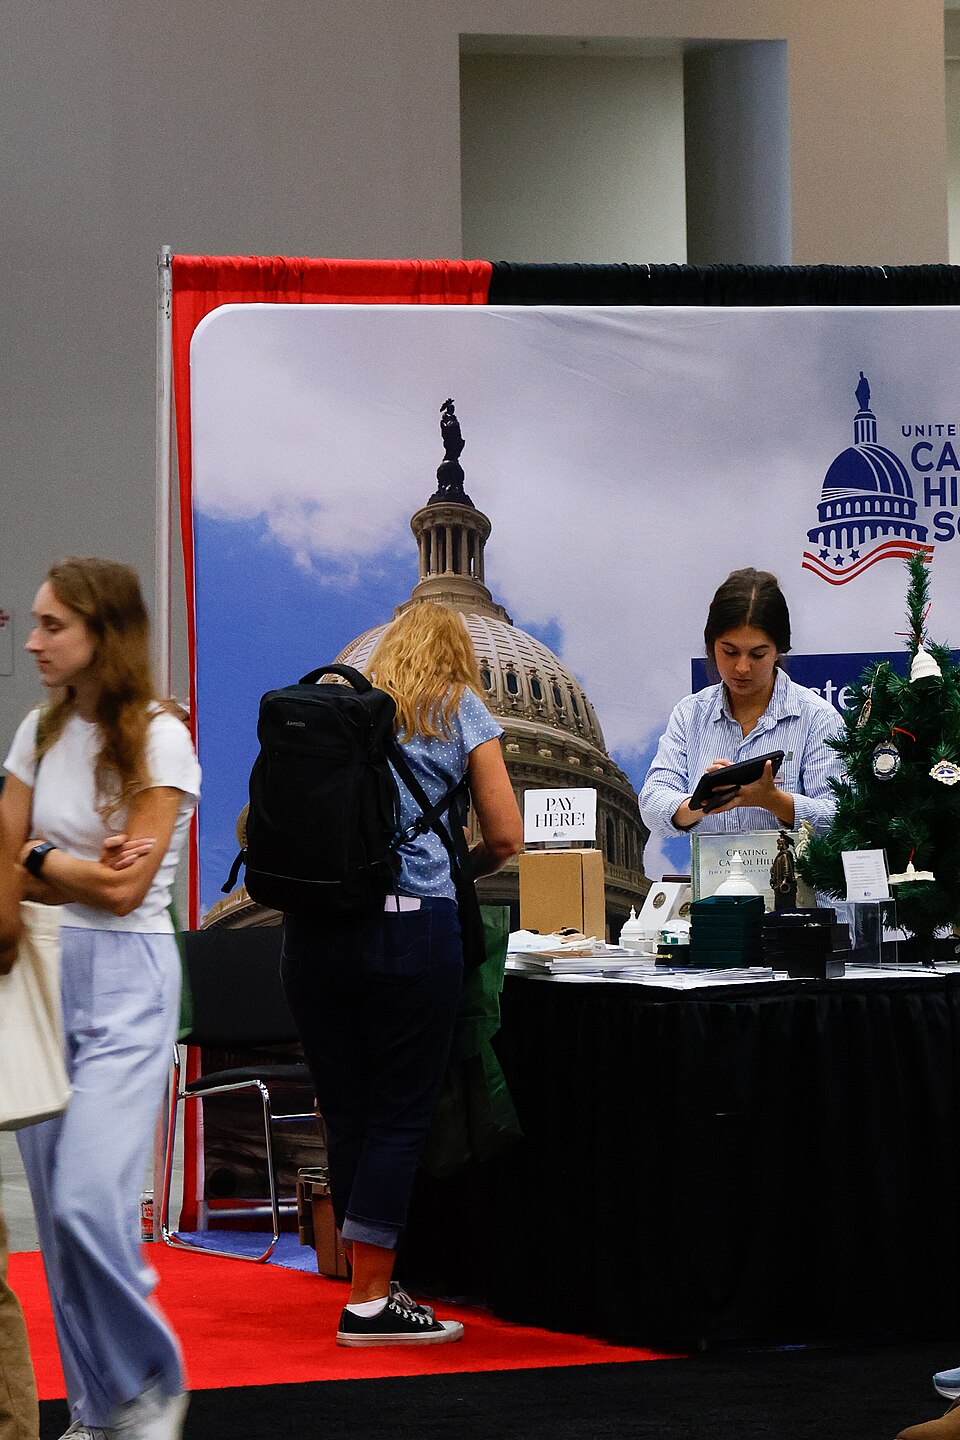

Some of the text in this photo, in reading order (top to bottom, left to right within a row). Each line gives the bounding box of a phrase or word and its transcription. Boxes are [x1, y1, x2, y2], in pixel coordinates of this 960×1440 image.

[546, 797, 575, 811] PAY
[535, 812, 585, 827] HERE!
[718, 859, 753, 867] CAOL
